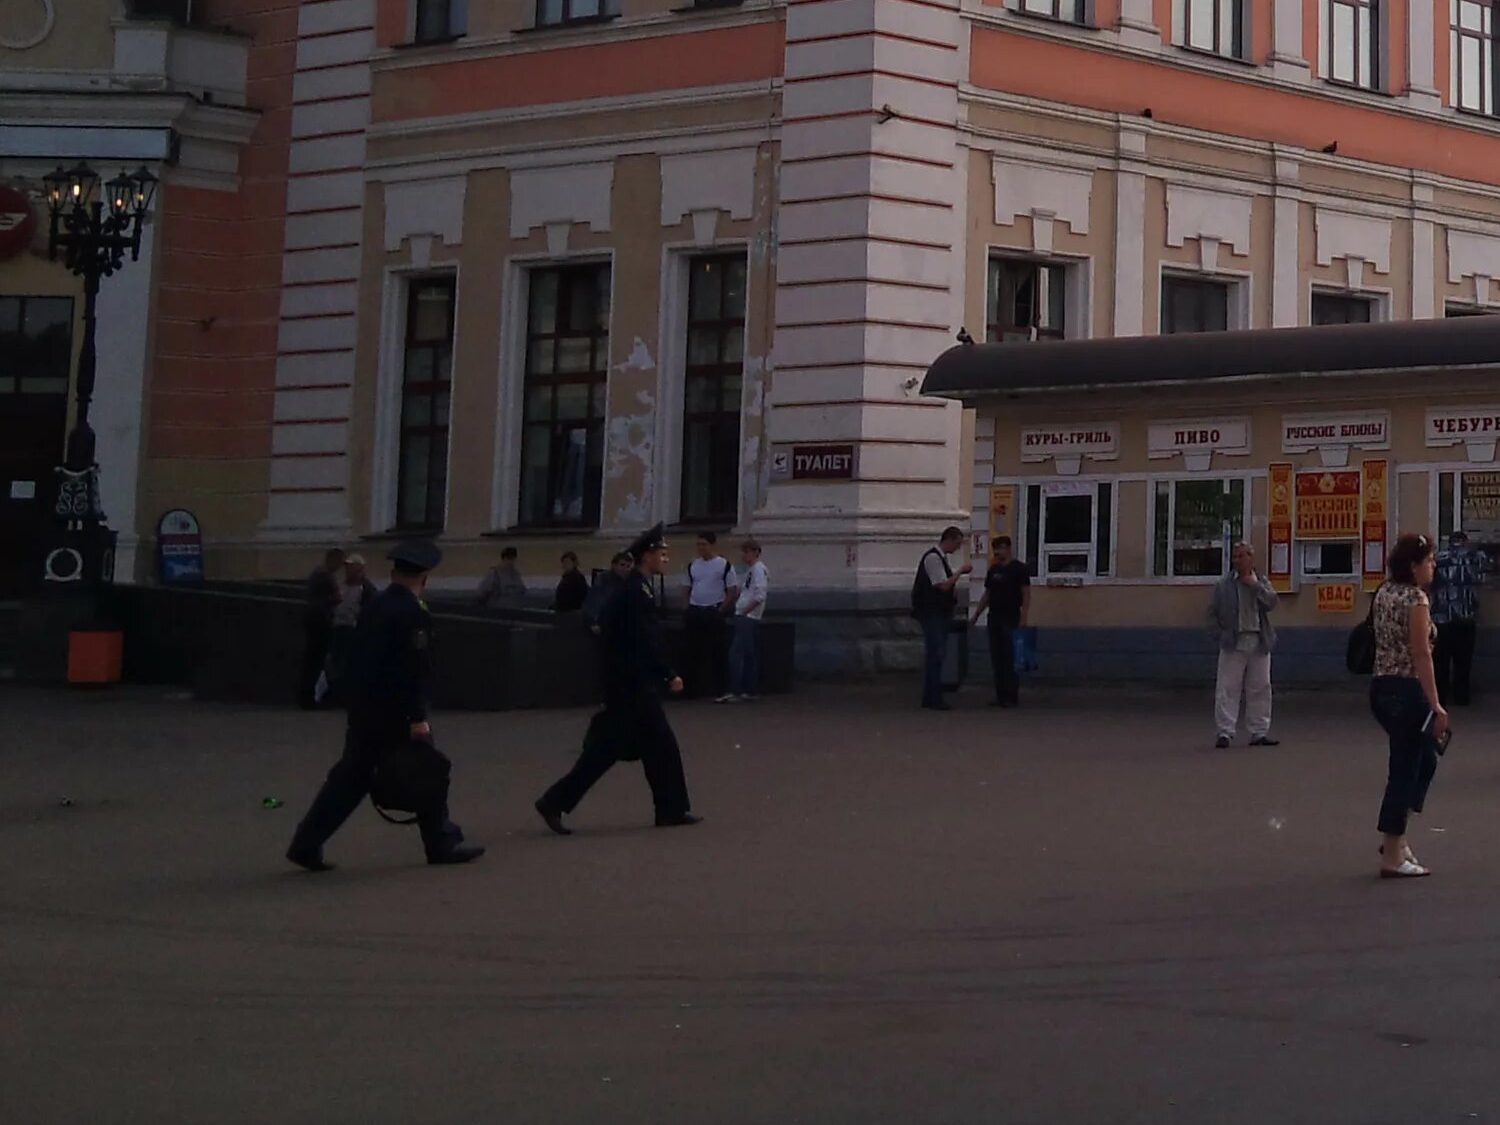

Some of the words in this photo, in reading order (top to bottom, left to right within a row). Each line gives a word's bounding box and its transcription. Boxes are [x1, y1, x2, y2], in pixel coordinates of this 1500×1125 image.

[1026, 431, 1112, 445] КУРЫ-ГРИЛЬ
[1175, 429, 1220, 445] ПИВО
[1286, 425, 1336, 439] РУССКИЕ
[1340, 423, 1382, 437] БЛИНЫ
[794, 454, 852, 471] ТУАЛЕТ
[1318, 586, 1352, 602] КВАС
